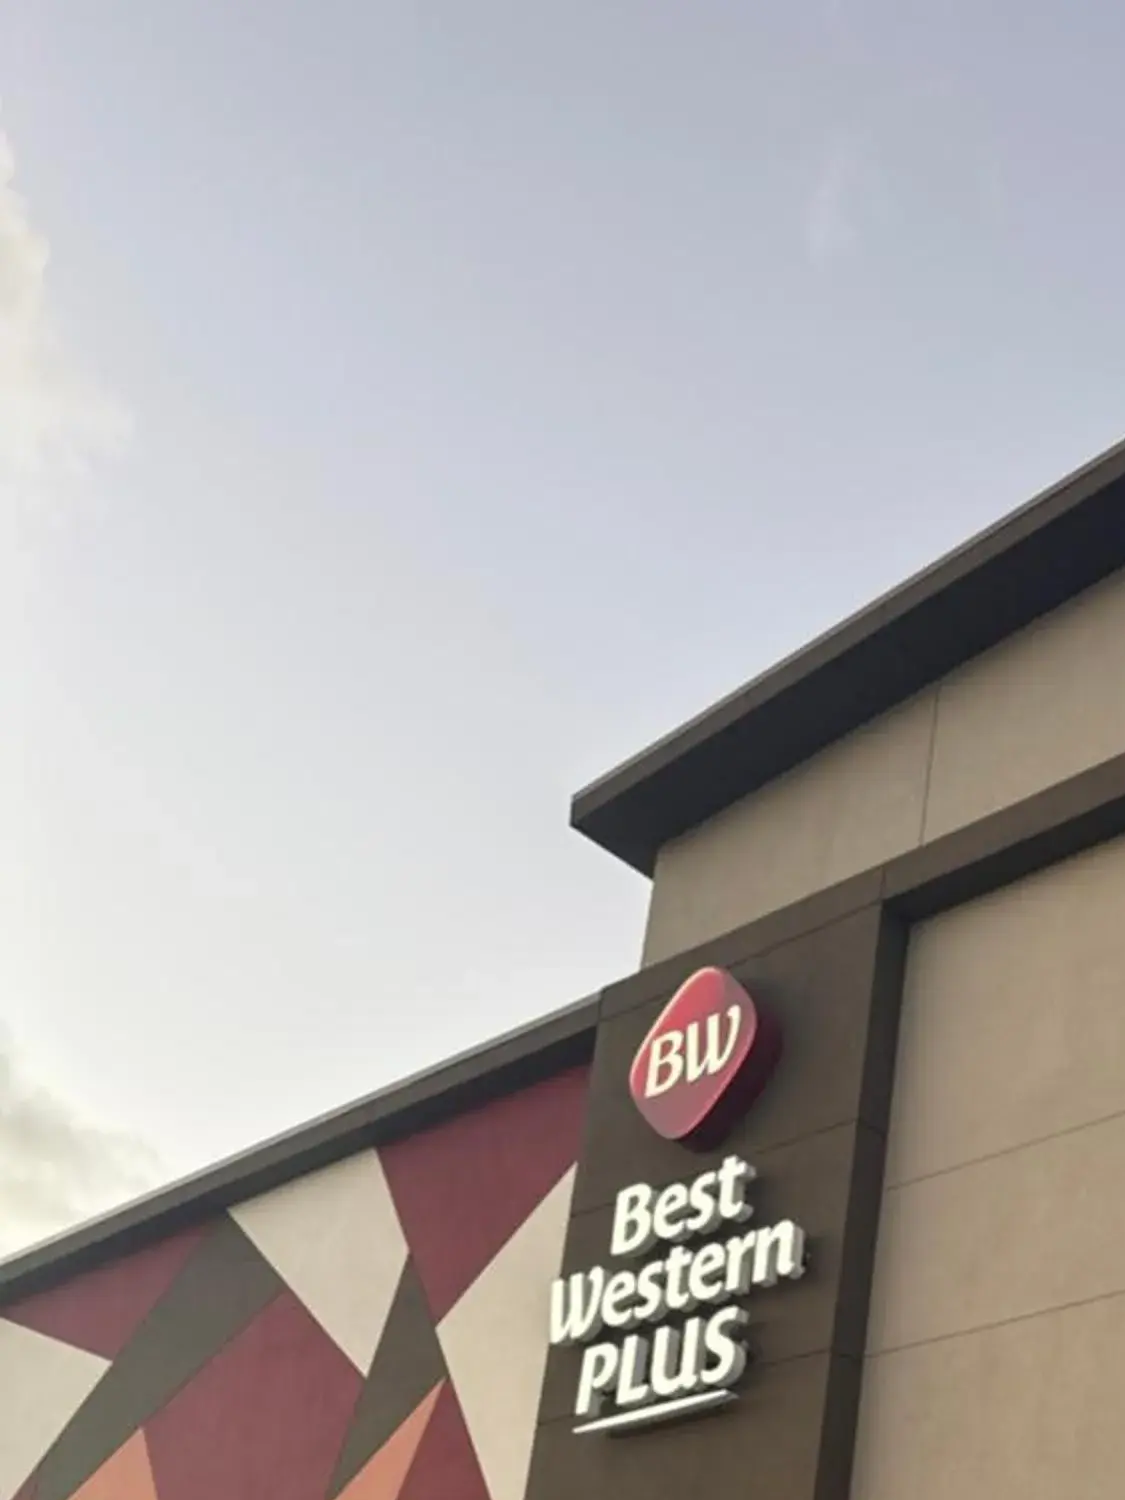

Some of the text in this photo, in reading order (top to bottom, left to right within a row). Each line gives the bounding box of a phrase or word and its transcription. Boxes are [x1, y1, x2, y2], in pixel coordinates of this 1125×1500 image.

[644, 1004, 741, 1099] BW
[610, 1154, 750, 1256] Best
[549, 1218, 800, 1345] Western
[575, 1304, 740, 1416] PLUS
